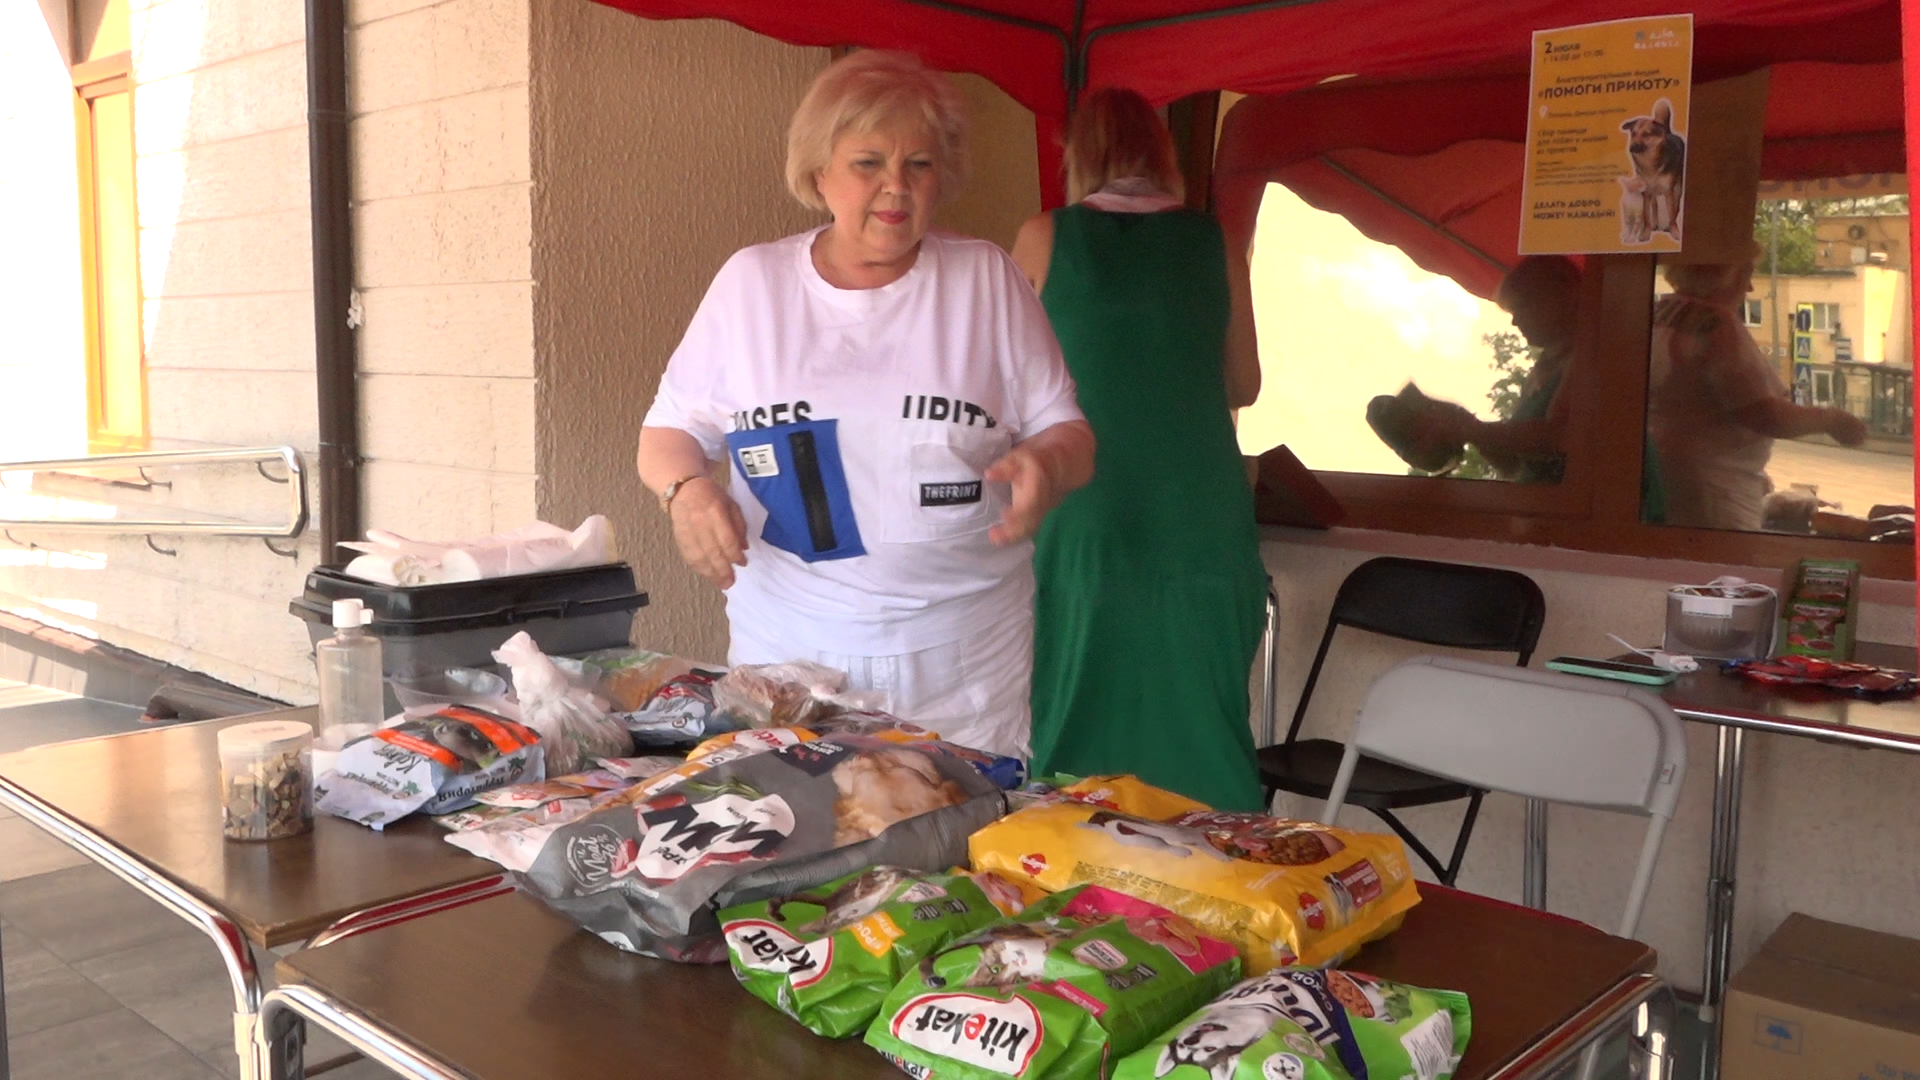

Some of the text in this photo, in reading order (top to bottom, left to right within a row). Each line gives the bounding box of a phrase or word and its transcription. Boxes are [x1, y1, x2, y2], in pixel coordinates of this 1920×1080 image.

[1544, 42, 1553, 54] 2
[1538, 77, 1680, 100] «ПОМОГИ ПРИЮТУ»
[1534, 199, 1601, 209] ДЕЛАТЬ ДОБРО
[915, 1005, 1029, 1062] kitekat
